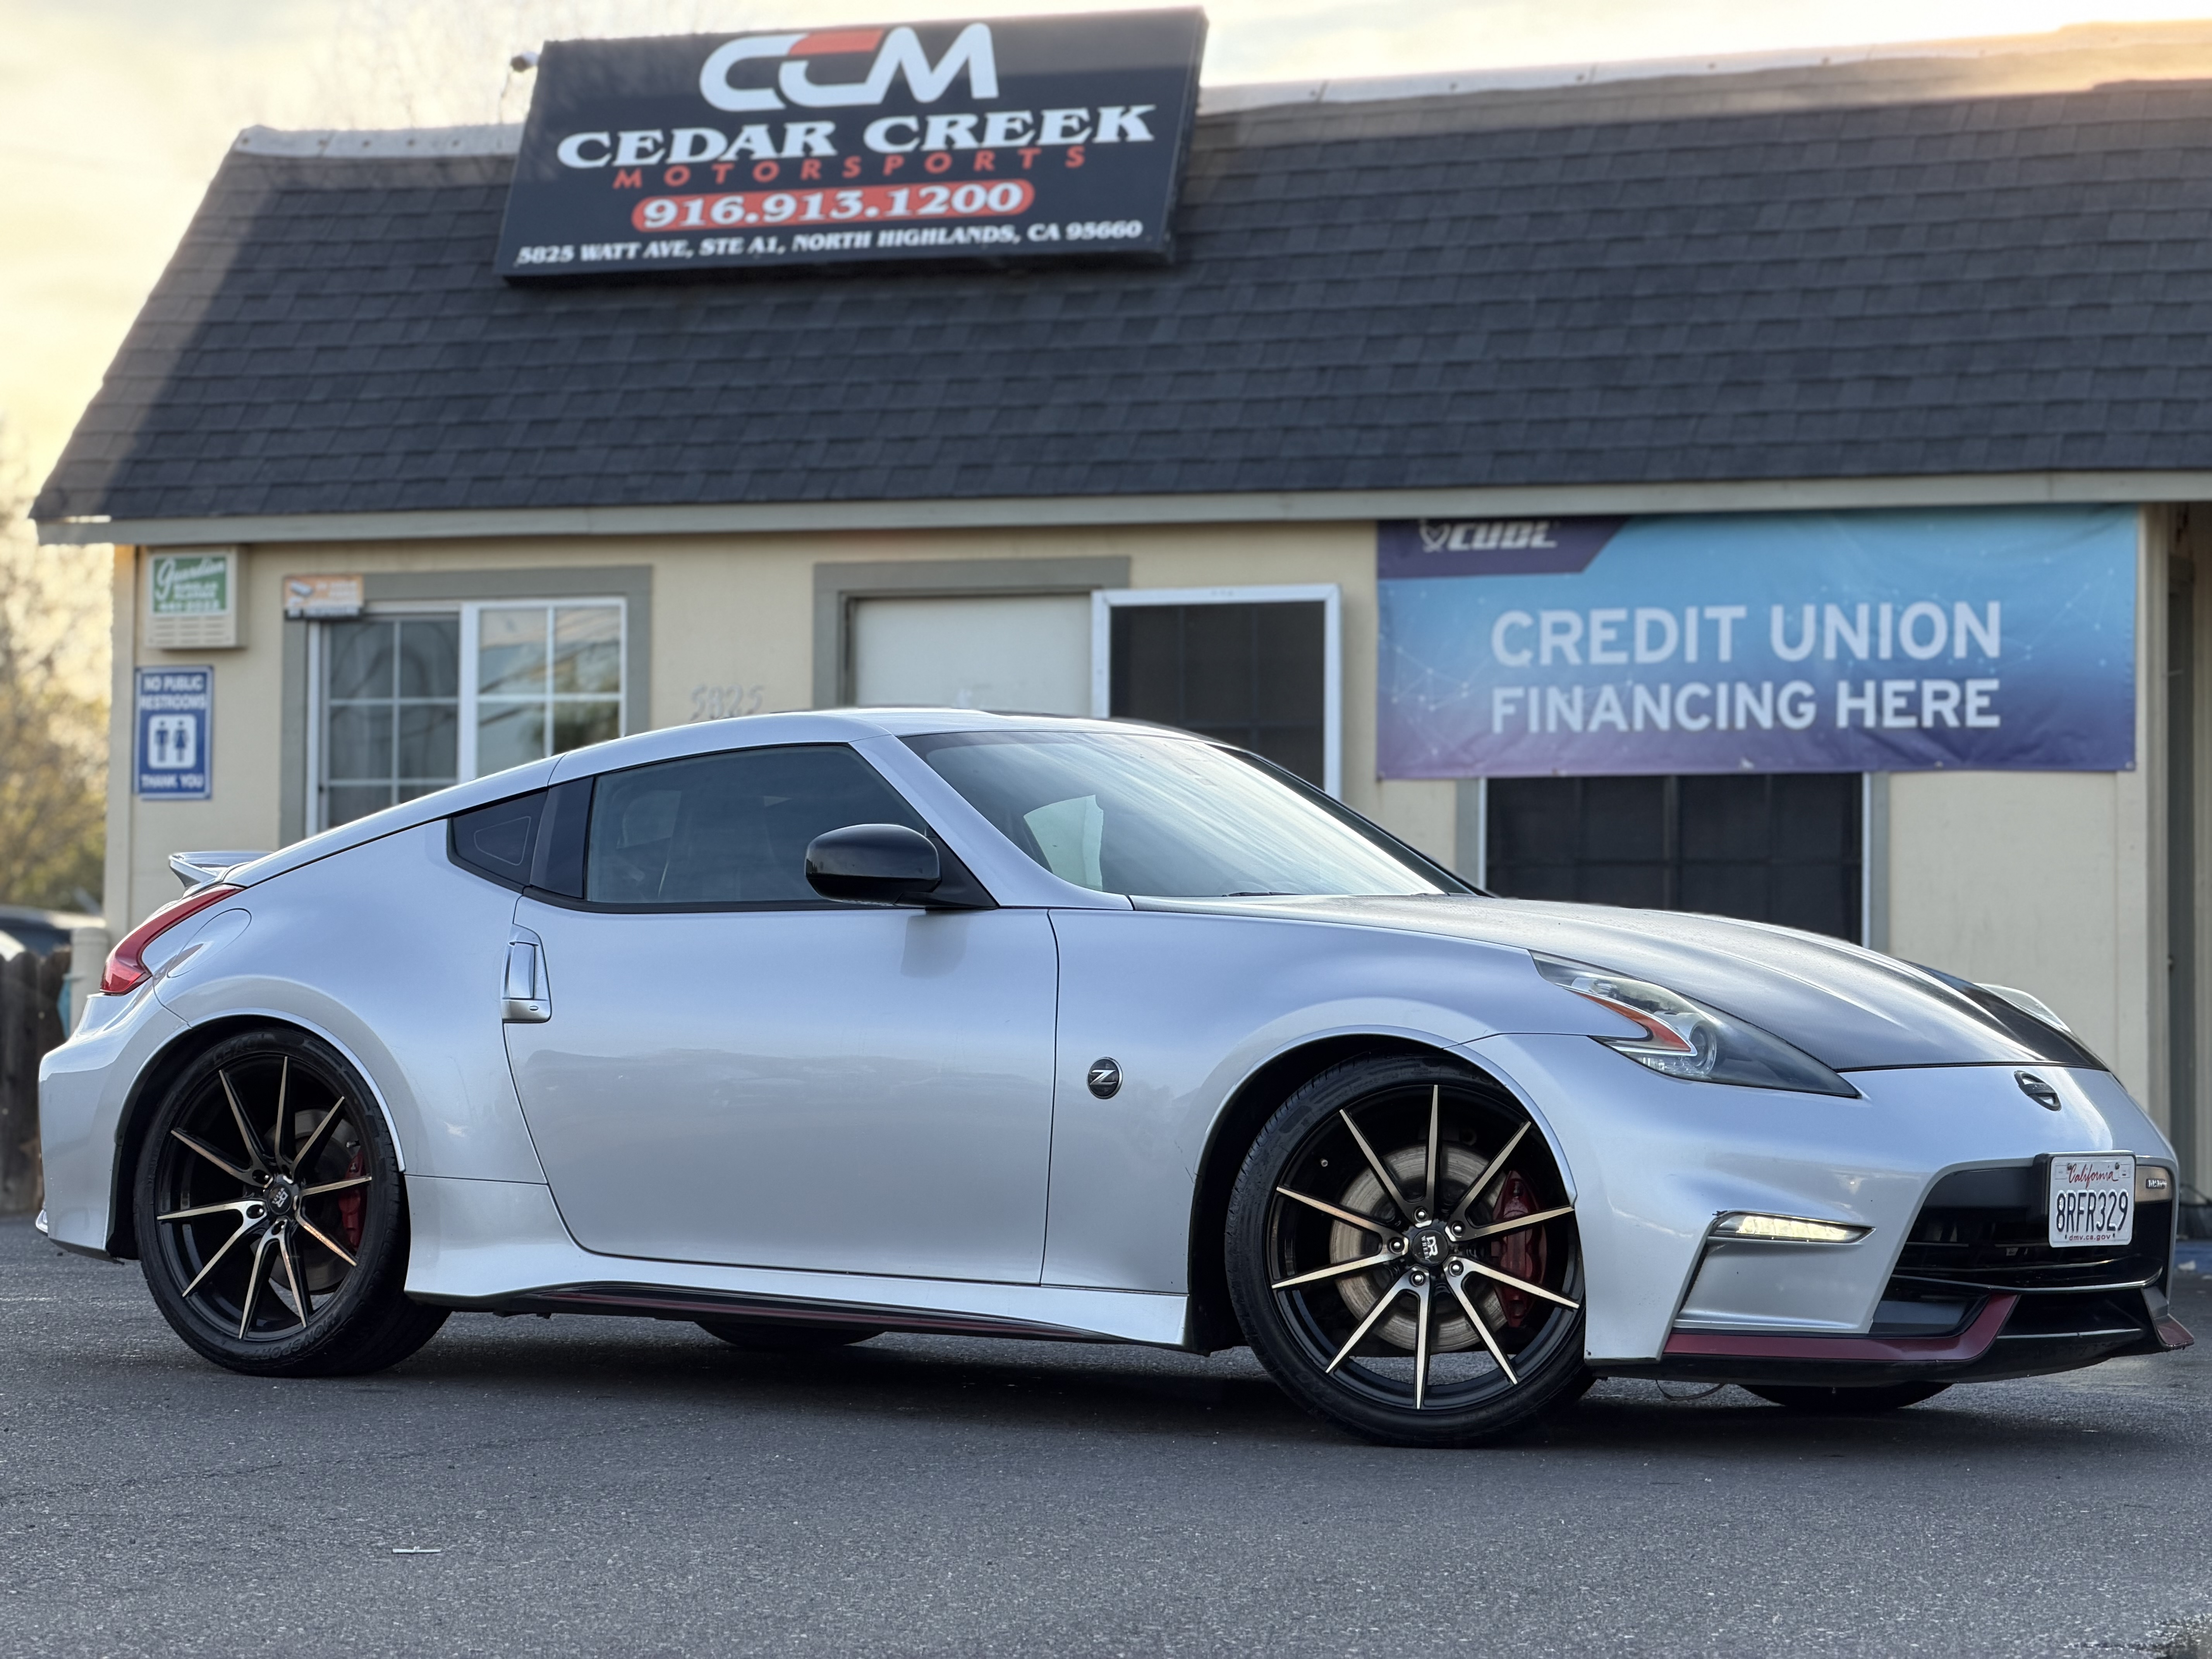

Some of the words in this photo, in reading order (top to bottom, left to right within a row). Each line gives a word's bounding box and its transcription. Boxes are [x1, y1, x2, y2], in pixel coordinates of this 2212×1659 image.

[557, 121, 837, 168] CEDAR
[864, 105, 1156, 153] CREEK
[613, 146, 1085, 189] MOTORSPORTS
[643, 182, 1024, 228] 916.913.1200
[517, 245, 574, 264] 5825
[581, 242, 641, 261] WATT
[644, 240, 694, 258] AVE,
[699, 237, 744, 256] STE
[747, 236, 785, 254] A1,
[792, 231, 872, 251] NORTH
[877, 225, 1021, 247] HIGHLANDS,
[1027, 223, 1060, 241] CA
[1066, 220, 1143, 240] 95660
[1491, 606, 1747, 668] CREDIT
[1771, 601, 2001, 661] UNION
[144, 676, 161, 692] NO
[163, 675, 204, 692] PUBLIC
[1492, 680, 1815, 734] FINANCING
[1838, 680, 1999, 727] HERE
[180, 775, 203, 788] YOU
[1089, 1069, 1117, 1085] Z
[2068, 1163, 2119, 1189] California
[2056, 1191, 2128, 1232] 8RFR329
